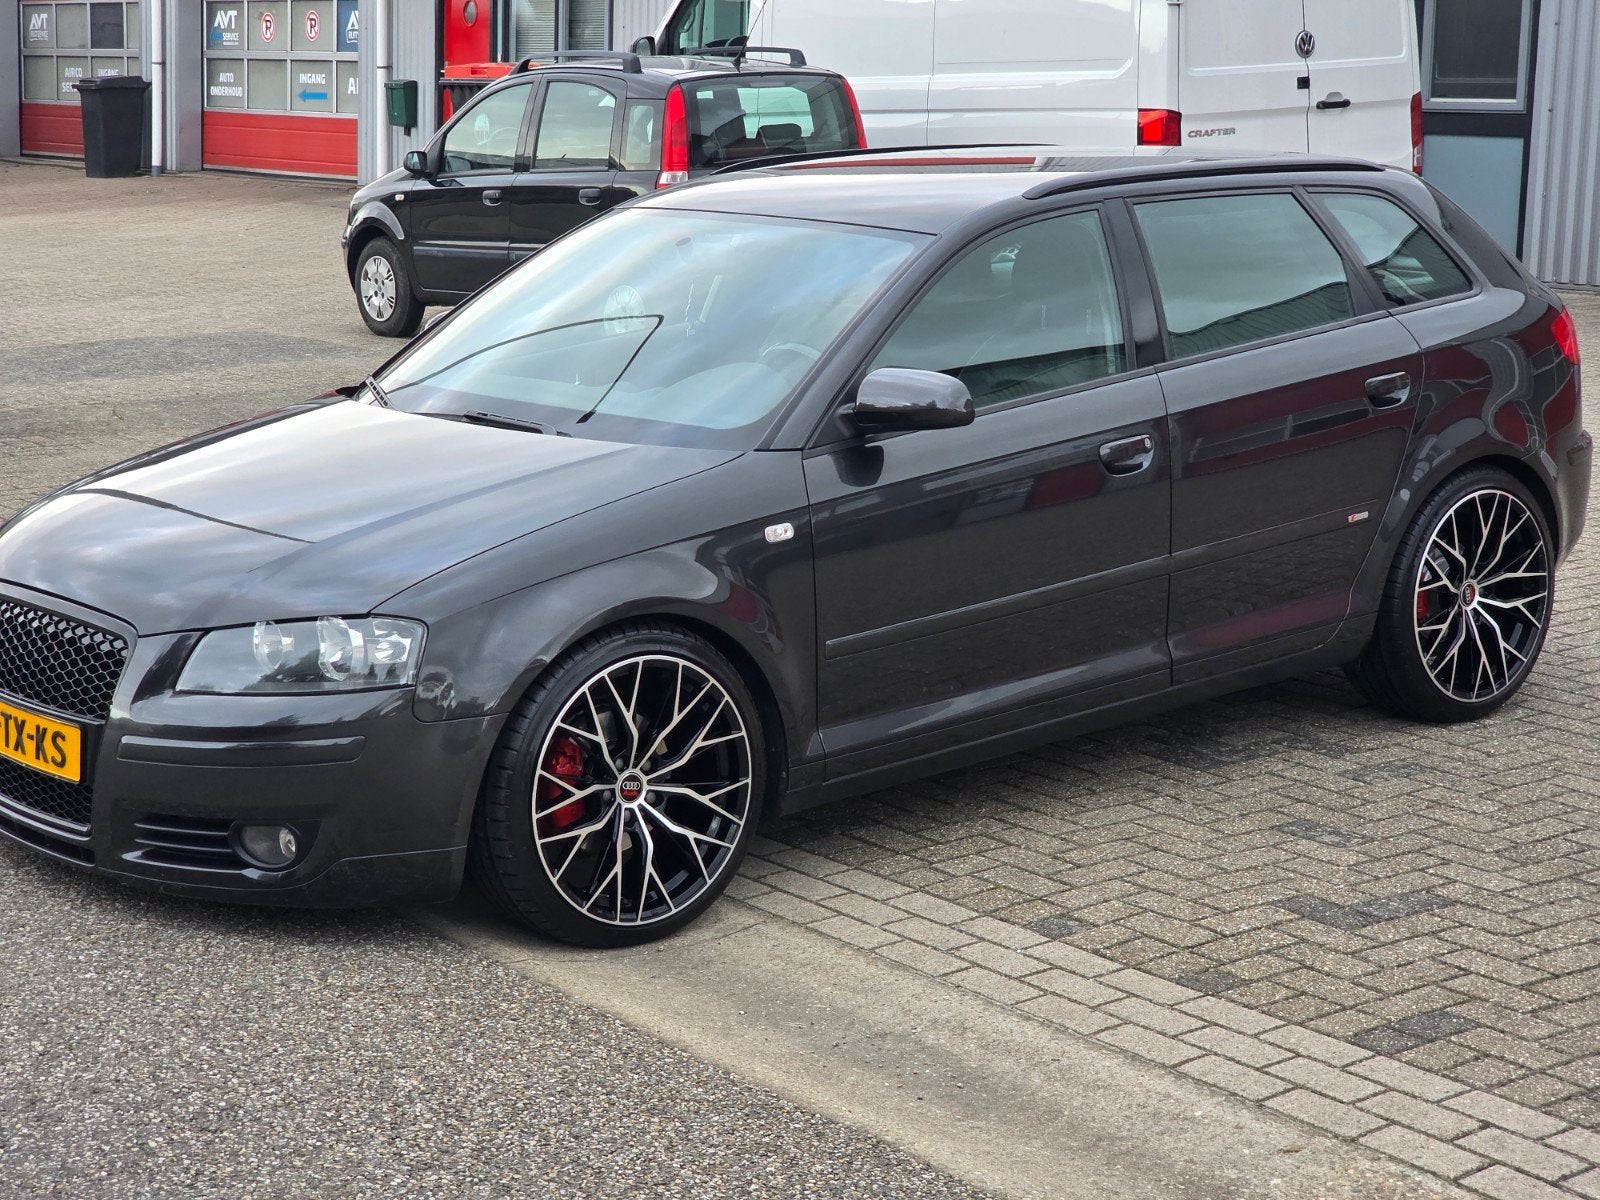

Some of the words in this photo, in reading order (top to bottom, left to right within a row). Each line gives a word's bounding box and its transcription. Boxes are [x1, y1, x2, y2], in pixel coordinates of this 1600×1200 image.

[30, 13, 48, 29] AVT
[214, 10, 237, 29] AVT
[222, 32, 239, 41] SERVICE
[65, 67, 82, 78] AIRCO
[220, 72, 234, 82] AUTO
[299, 73, 326, 85] INGANG
[210, 85, 243, 97] ONDERHOUD
[1187, 127, 1236, 138] CRAFTER
[0, 711, 67, 769] TX-KS
